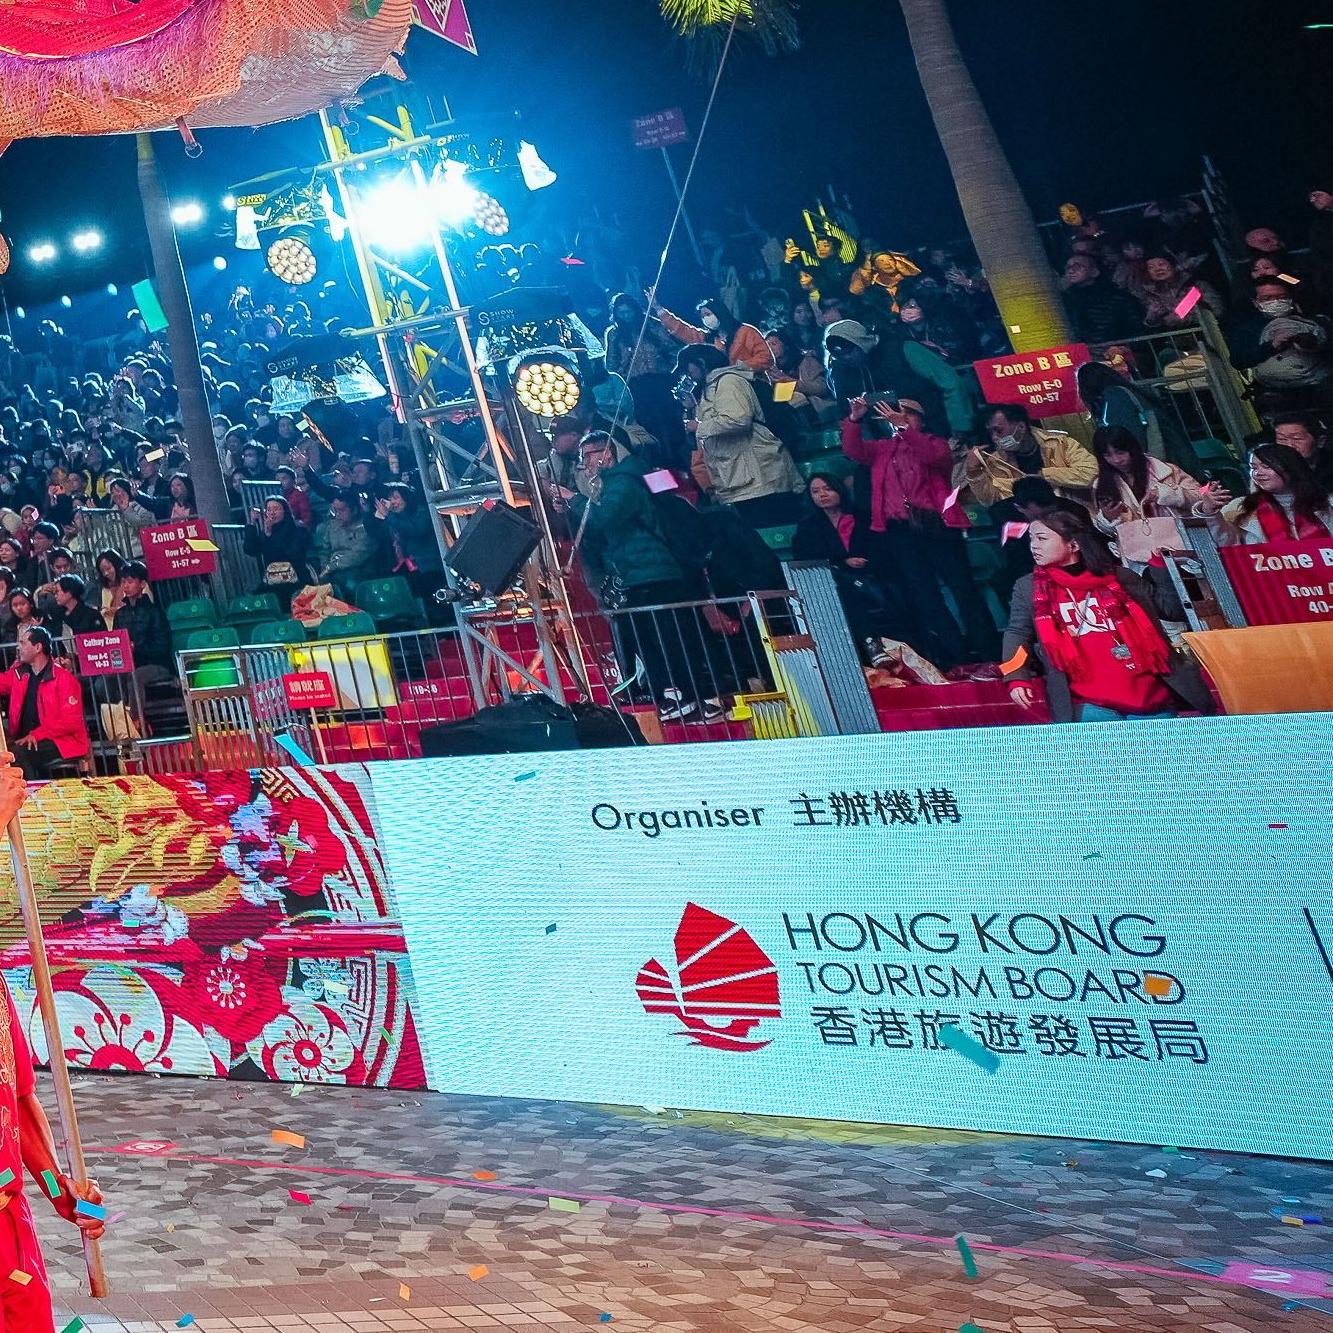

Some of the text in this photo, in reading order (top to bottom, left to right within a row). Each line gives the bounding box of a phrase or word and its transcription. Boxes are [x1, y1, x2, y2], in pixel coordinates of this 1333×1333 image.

[992, 351, 1074, 378] Zone B 區
[1017, 383, 1042, 395] Row
[1029, 391, 1060, 405] 40-57
[150, 531, 176, 544] Zone
[177, 527, 186, 540] B
[164, 549, 179, 558] Row
[1249, 552, 1314, 573] Zone
[1286, 584, 1324, 599] Row
[83, 636, 121, 648] Cathay Zone
[591, 787, 963, 839] Organiser 主辦機構
[781, 912, 1169, 957] HONG KONG
[795, 961, 1187, 1006] TOURISM BOARD
